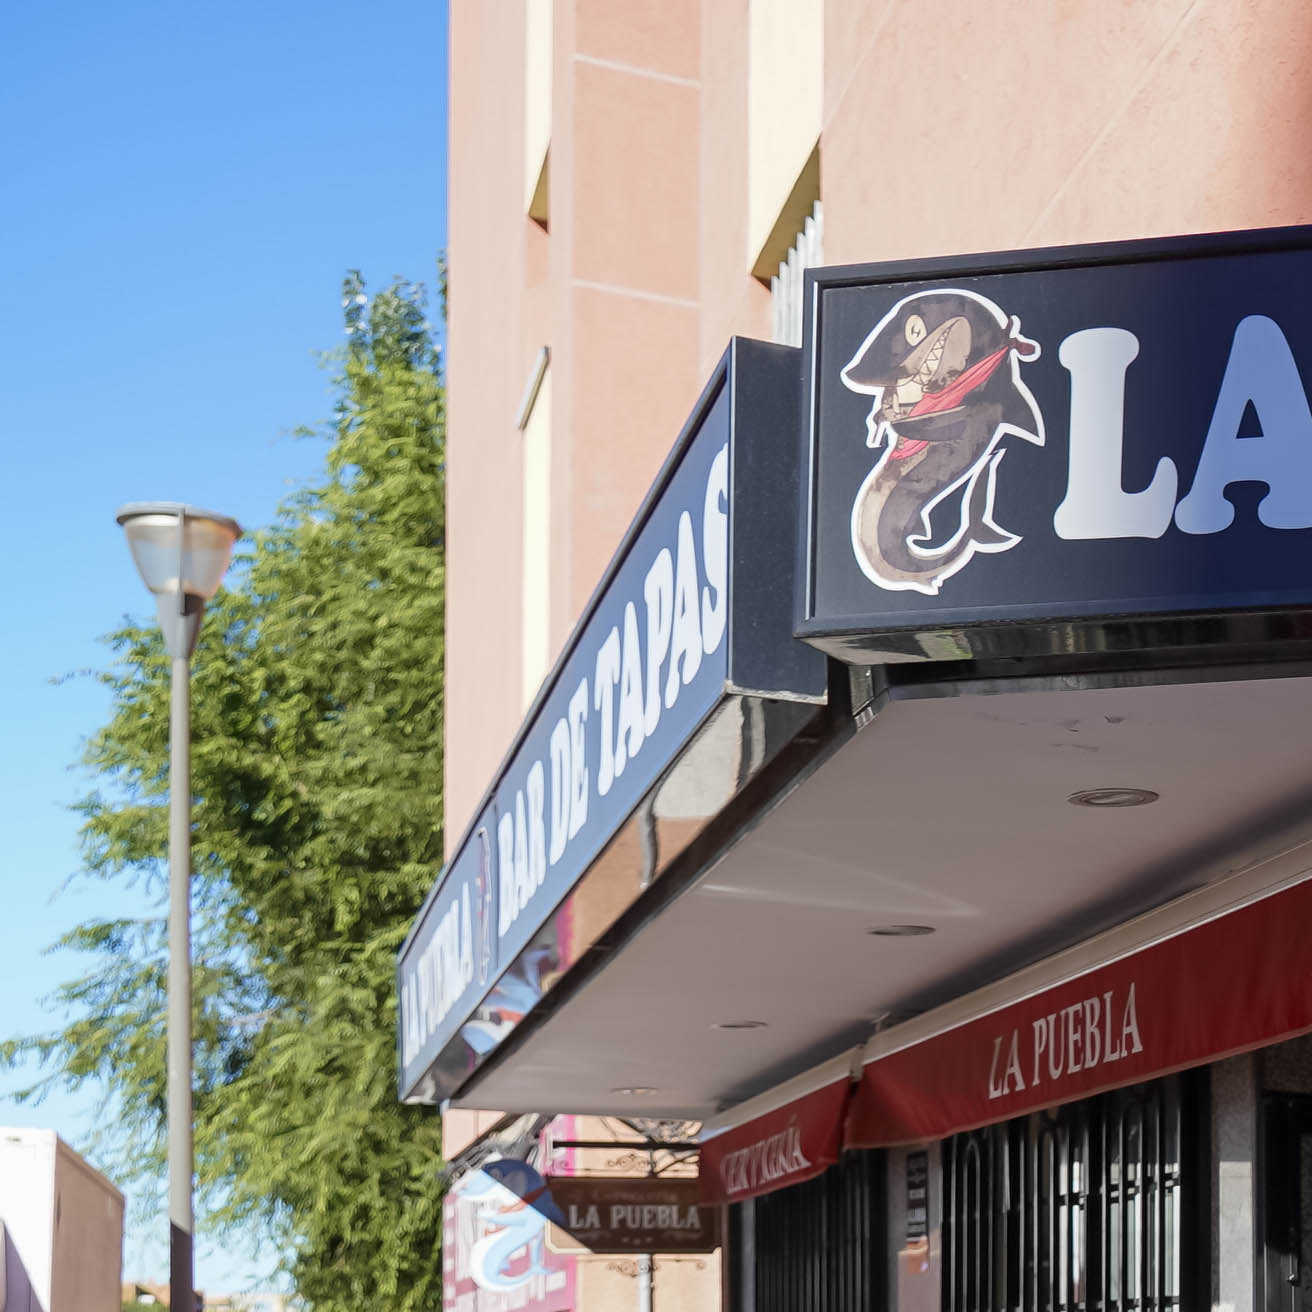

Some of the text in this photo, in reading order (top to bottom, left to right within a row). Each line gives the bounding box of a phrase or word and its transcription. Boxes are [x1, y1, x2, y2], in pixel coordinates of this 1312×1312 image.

[497, 442, 729, 937] BAR DE TAPAS
[987, 982, 1143, 1100] LA PUEBLA
[569, 1204, 700, 1230] LA PUEBLA
